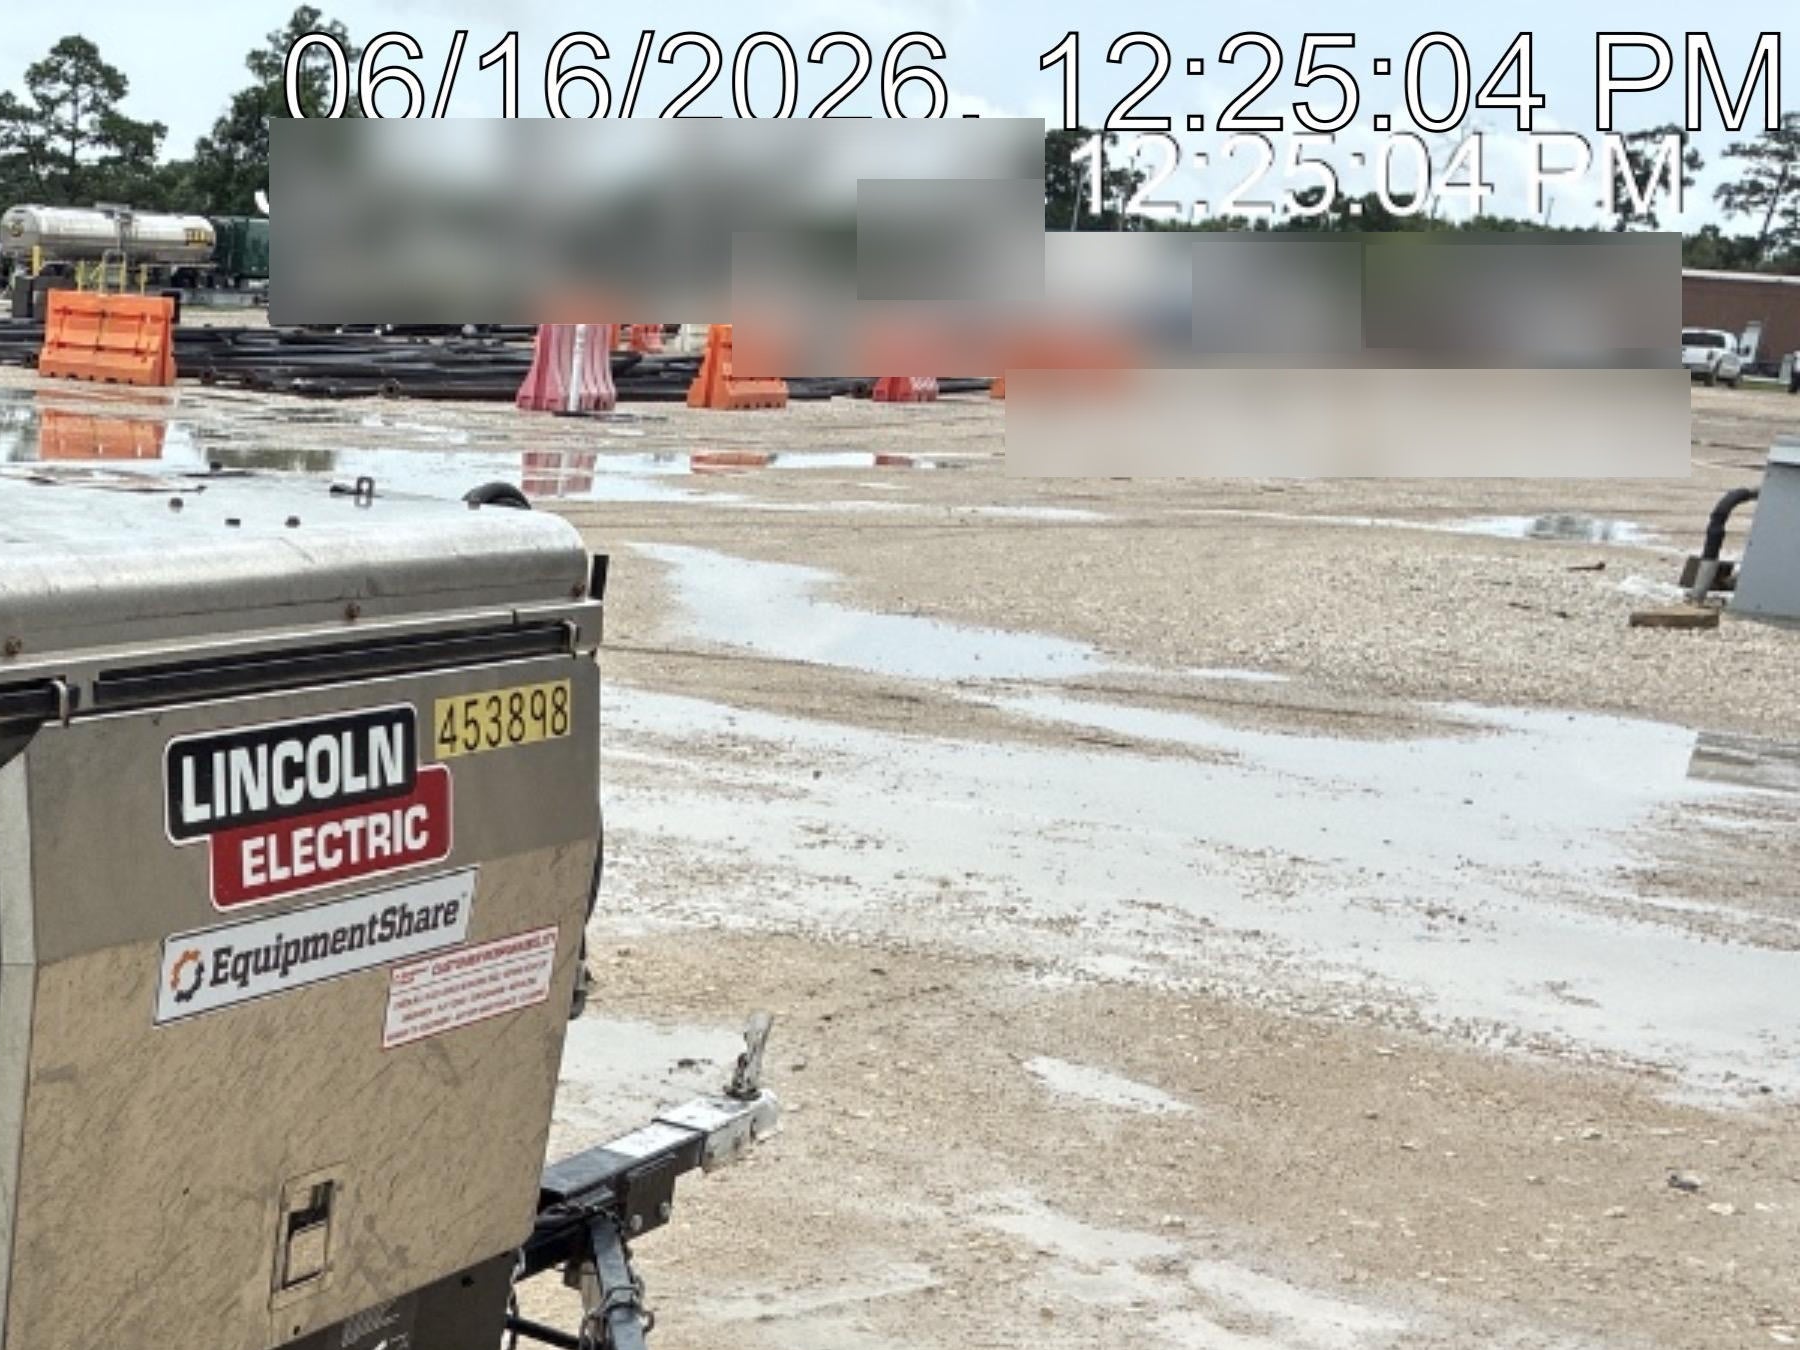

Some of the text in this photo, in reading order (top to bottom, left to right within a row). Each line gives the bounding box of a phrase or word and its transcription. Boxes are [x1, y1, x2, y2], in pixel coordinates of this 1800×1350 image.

[439, 685, 570, 754] 453898
[180, 722, 406, 824] LINCOLN
[241, 804, 431, 889] ELECTRIC
[209, 898, 460, 987] EquipmentShare
